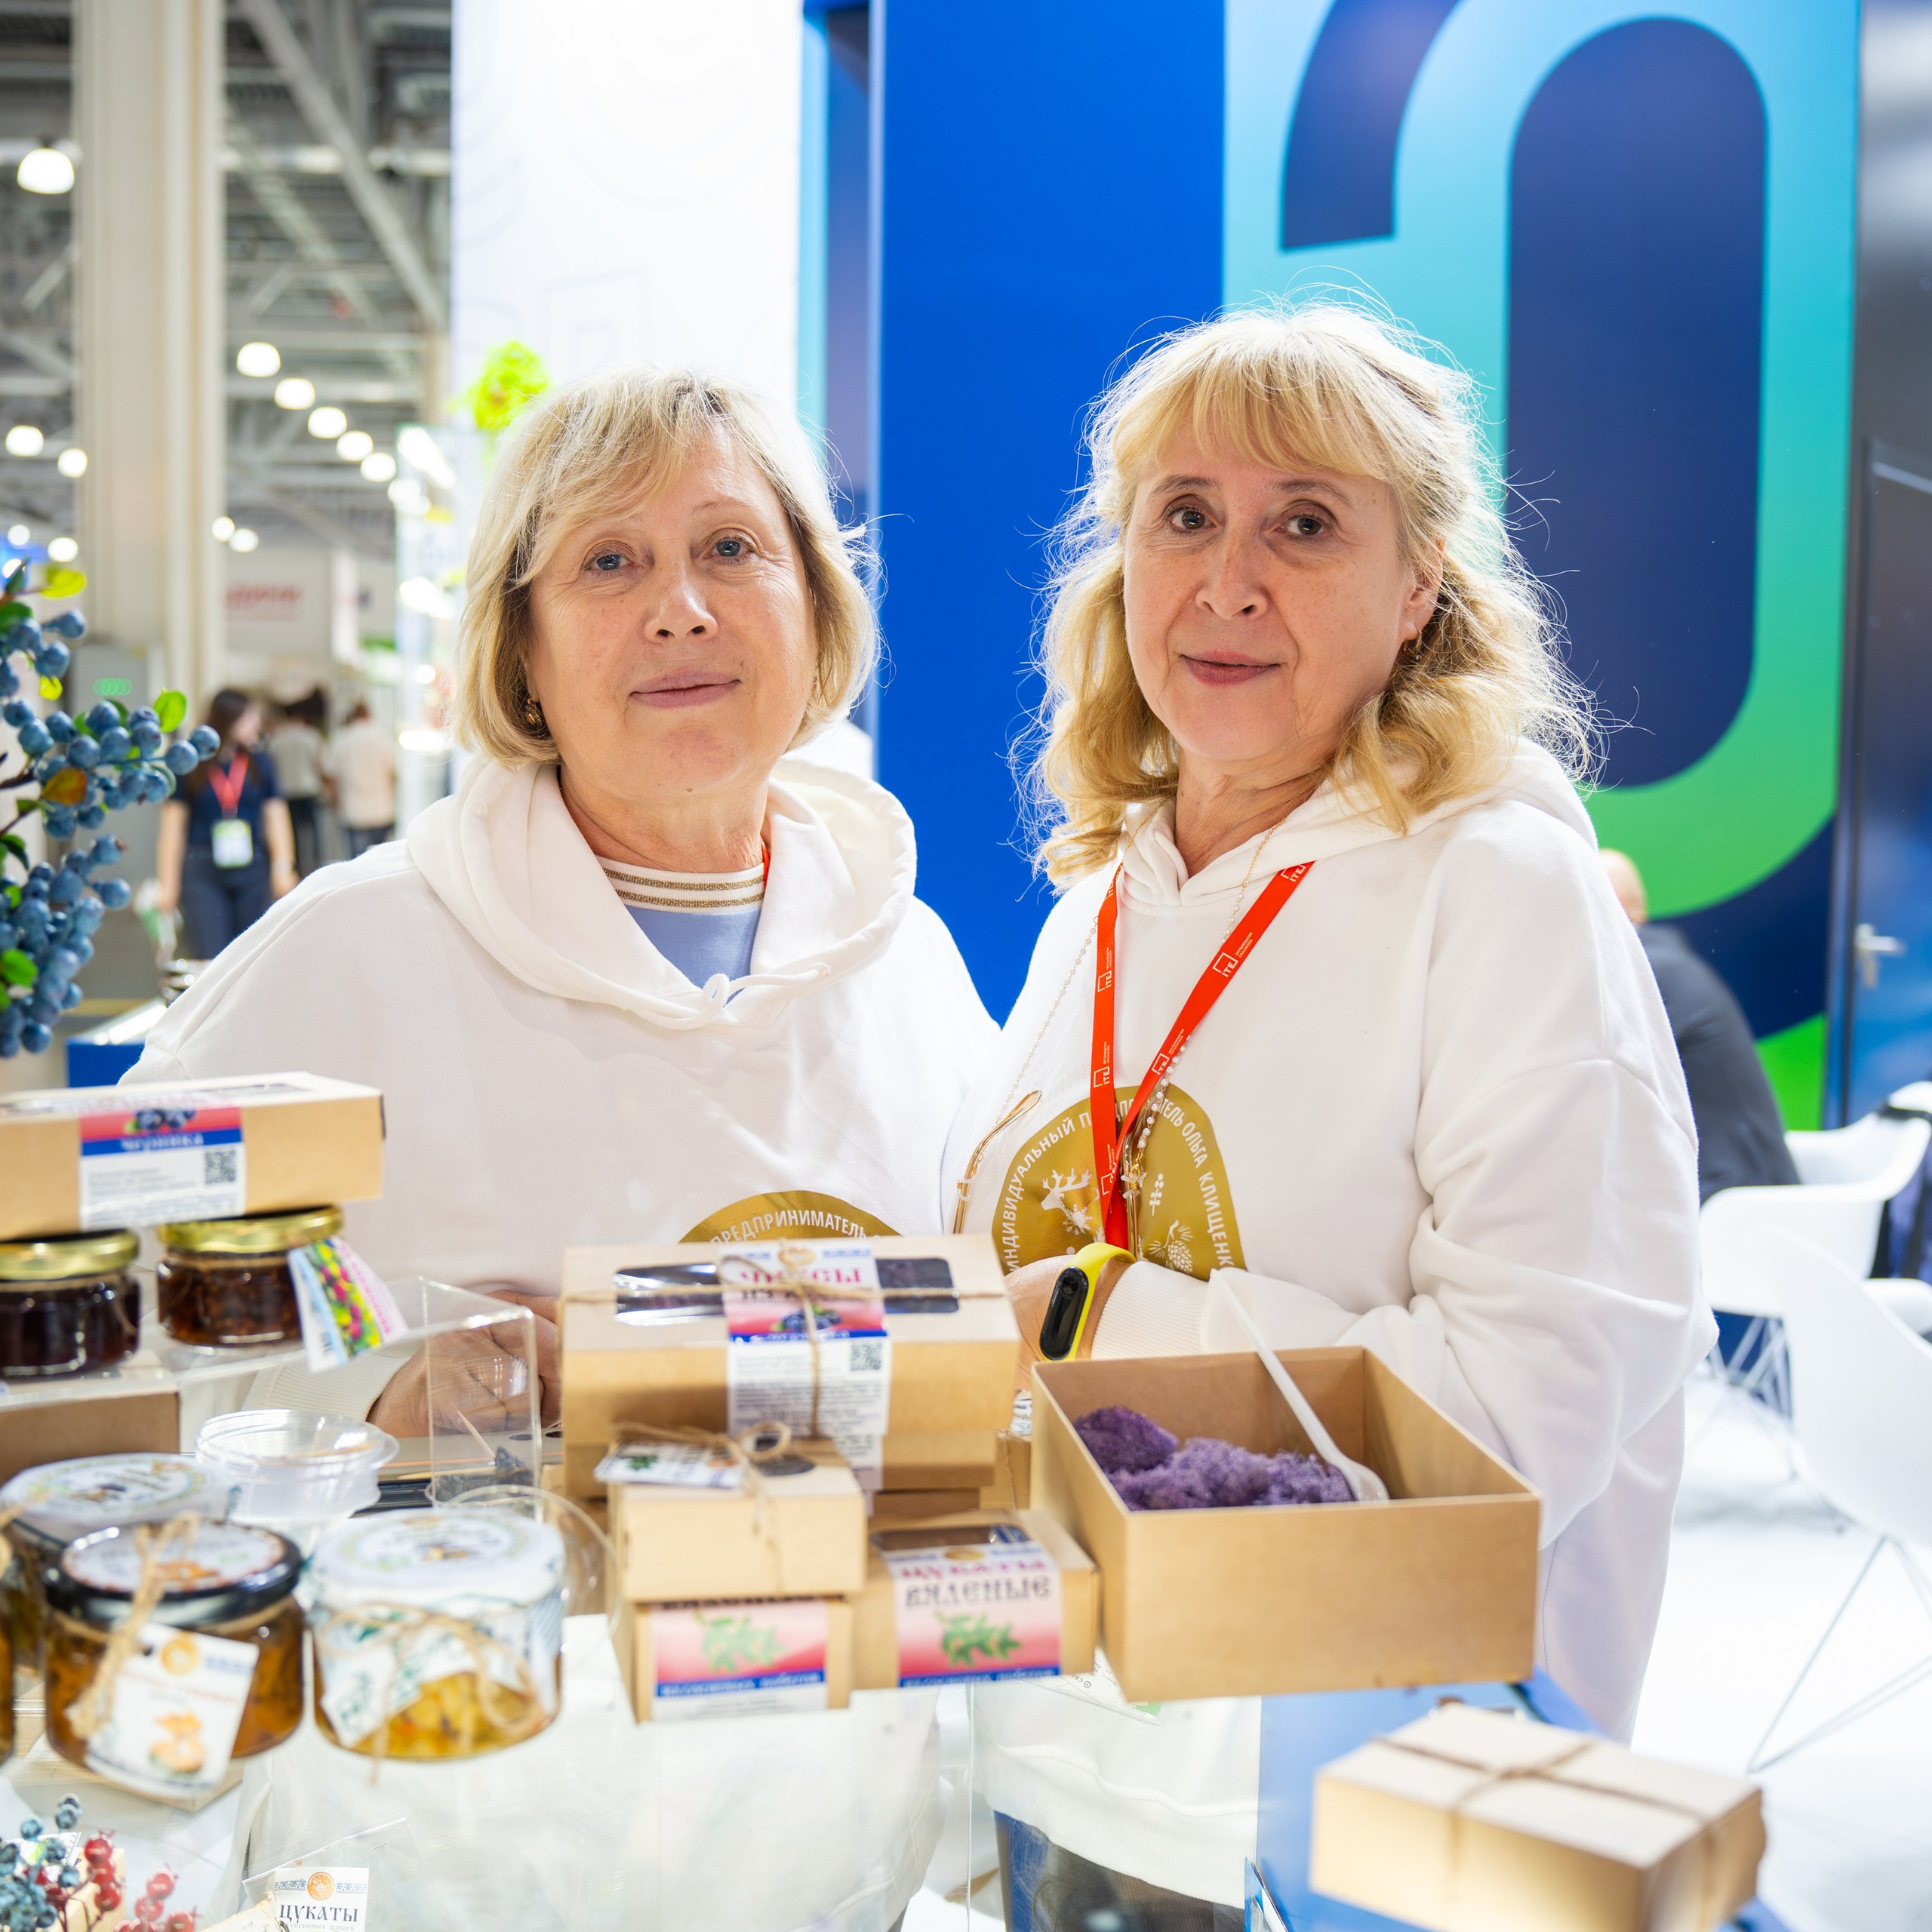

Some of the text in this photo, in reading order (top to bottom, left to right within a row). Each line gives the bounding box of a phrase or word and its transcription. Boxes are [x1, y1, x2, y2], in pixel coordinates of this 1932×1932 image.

[1235, 931, 1253, 956] ОРГАНИЗАТОР
[1156, 1060, 1168, 1075] ITE
[1001, 1117, 1075, 1272] ИНДИВИДУАЛЬНЫЙ
[1181, 1121, 1208, 1168] ОЛЬГА
[710, 1210, 866, 1245] ПРЕДПРИНИМАТЕЛЬ
[278, 1904, 358, 1923] ЦУКАТЫ
